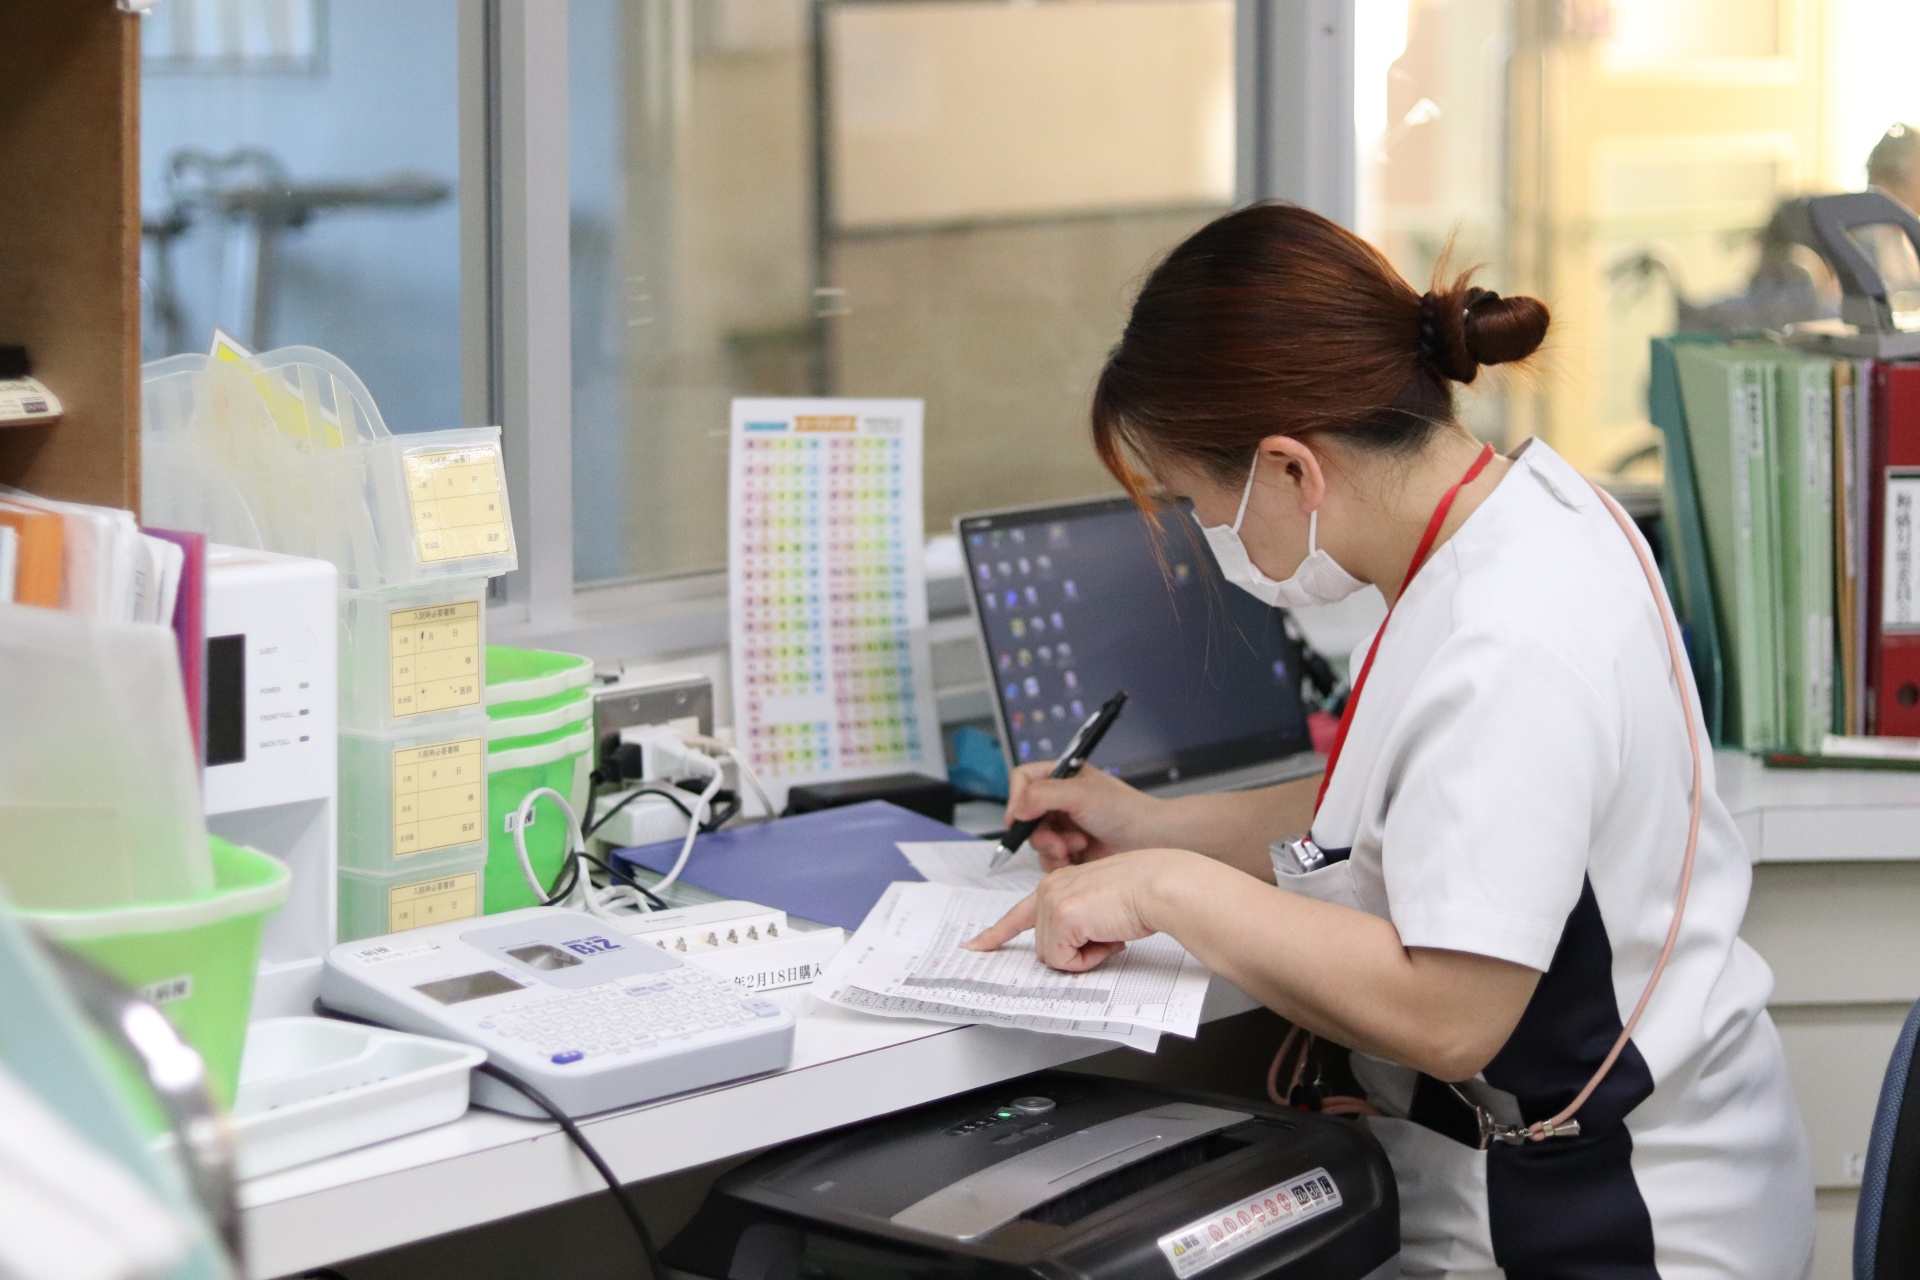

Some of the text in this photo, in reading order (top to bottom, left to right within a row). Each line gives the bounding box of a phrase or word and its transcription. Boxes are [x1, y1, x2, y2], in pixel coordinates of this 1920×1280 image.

[414, 607, 456, 620] 入院時必要書類
[428, 632, 433, 640] 月
[453, 628, 458, 637] 日
[260, 686, 281, 695] POWER
[460, 686, 472, 695] 医師
[277, 738, 291, 746] FULL
[417, 745, 460, 759] 入院時必要書類
[432, 770, 437, 779] 月
[456, 766, 461, 775] 日
[462, 822, 474, 832] 医師
[414, 880, 456, 895] 入院時必要書類
[428, 906, 433, 915] 月
[452, 901, 457, 909] 日
[734, 962, 822, 988] 年2月18日購入
